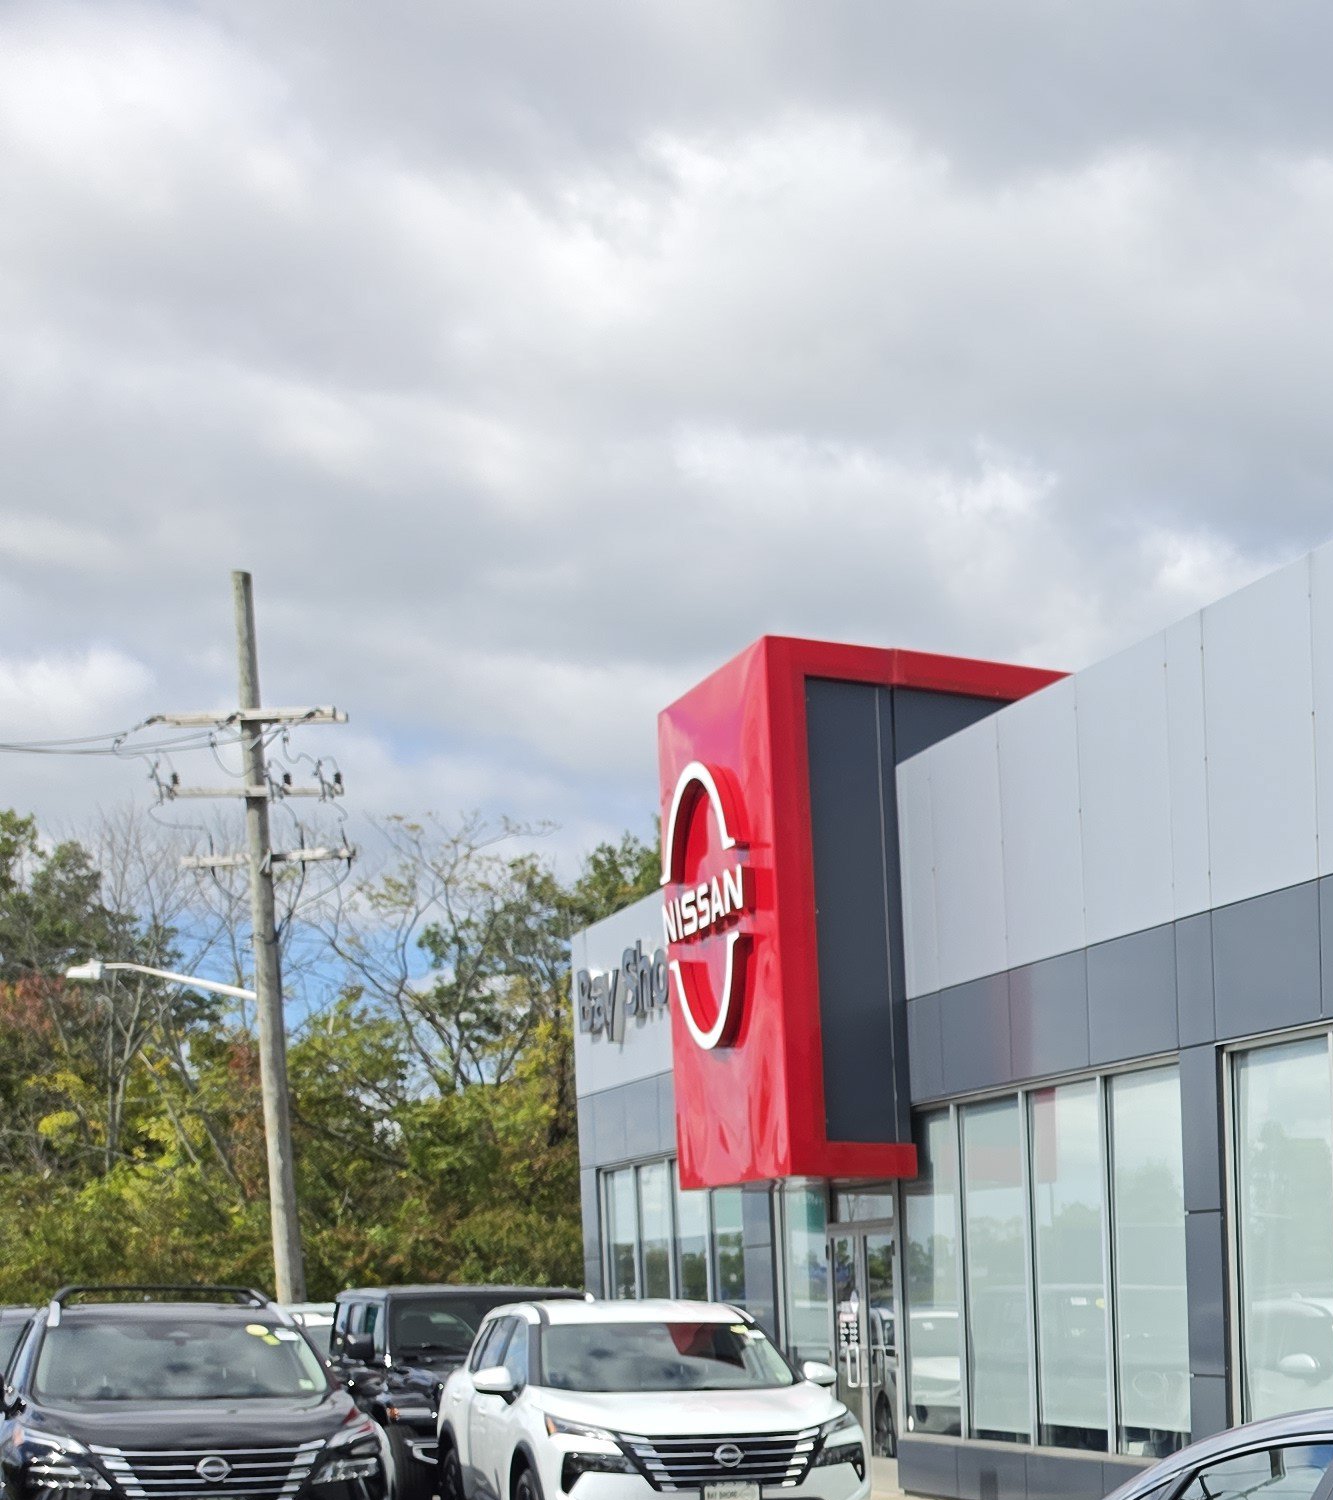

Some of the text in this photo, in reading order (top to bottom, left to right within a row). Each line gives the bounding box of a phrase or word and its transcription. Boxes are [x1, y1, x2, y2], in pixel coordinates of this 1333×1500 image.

[661, 863, 744, 944] NISSAN
[577, 939, 668, 1044] Bay Sho
